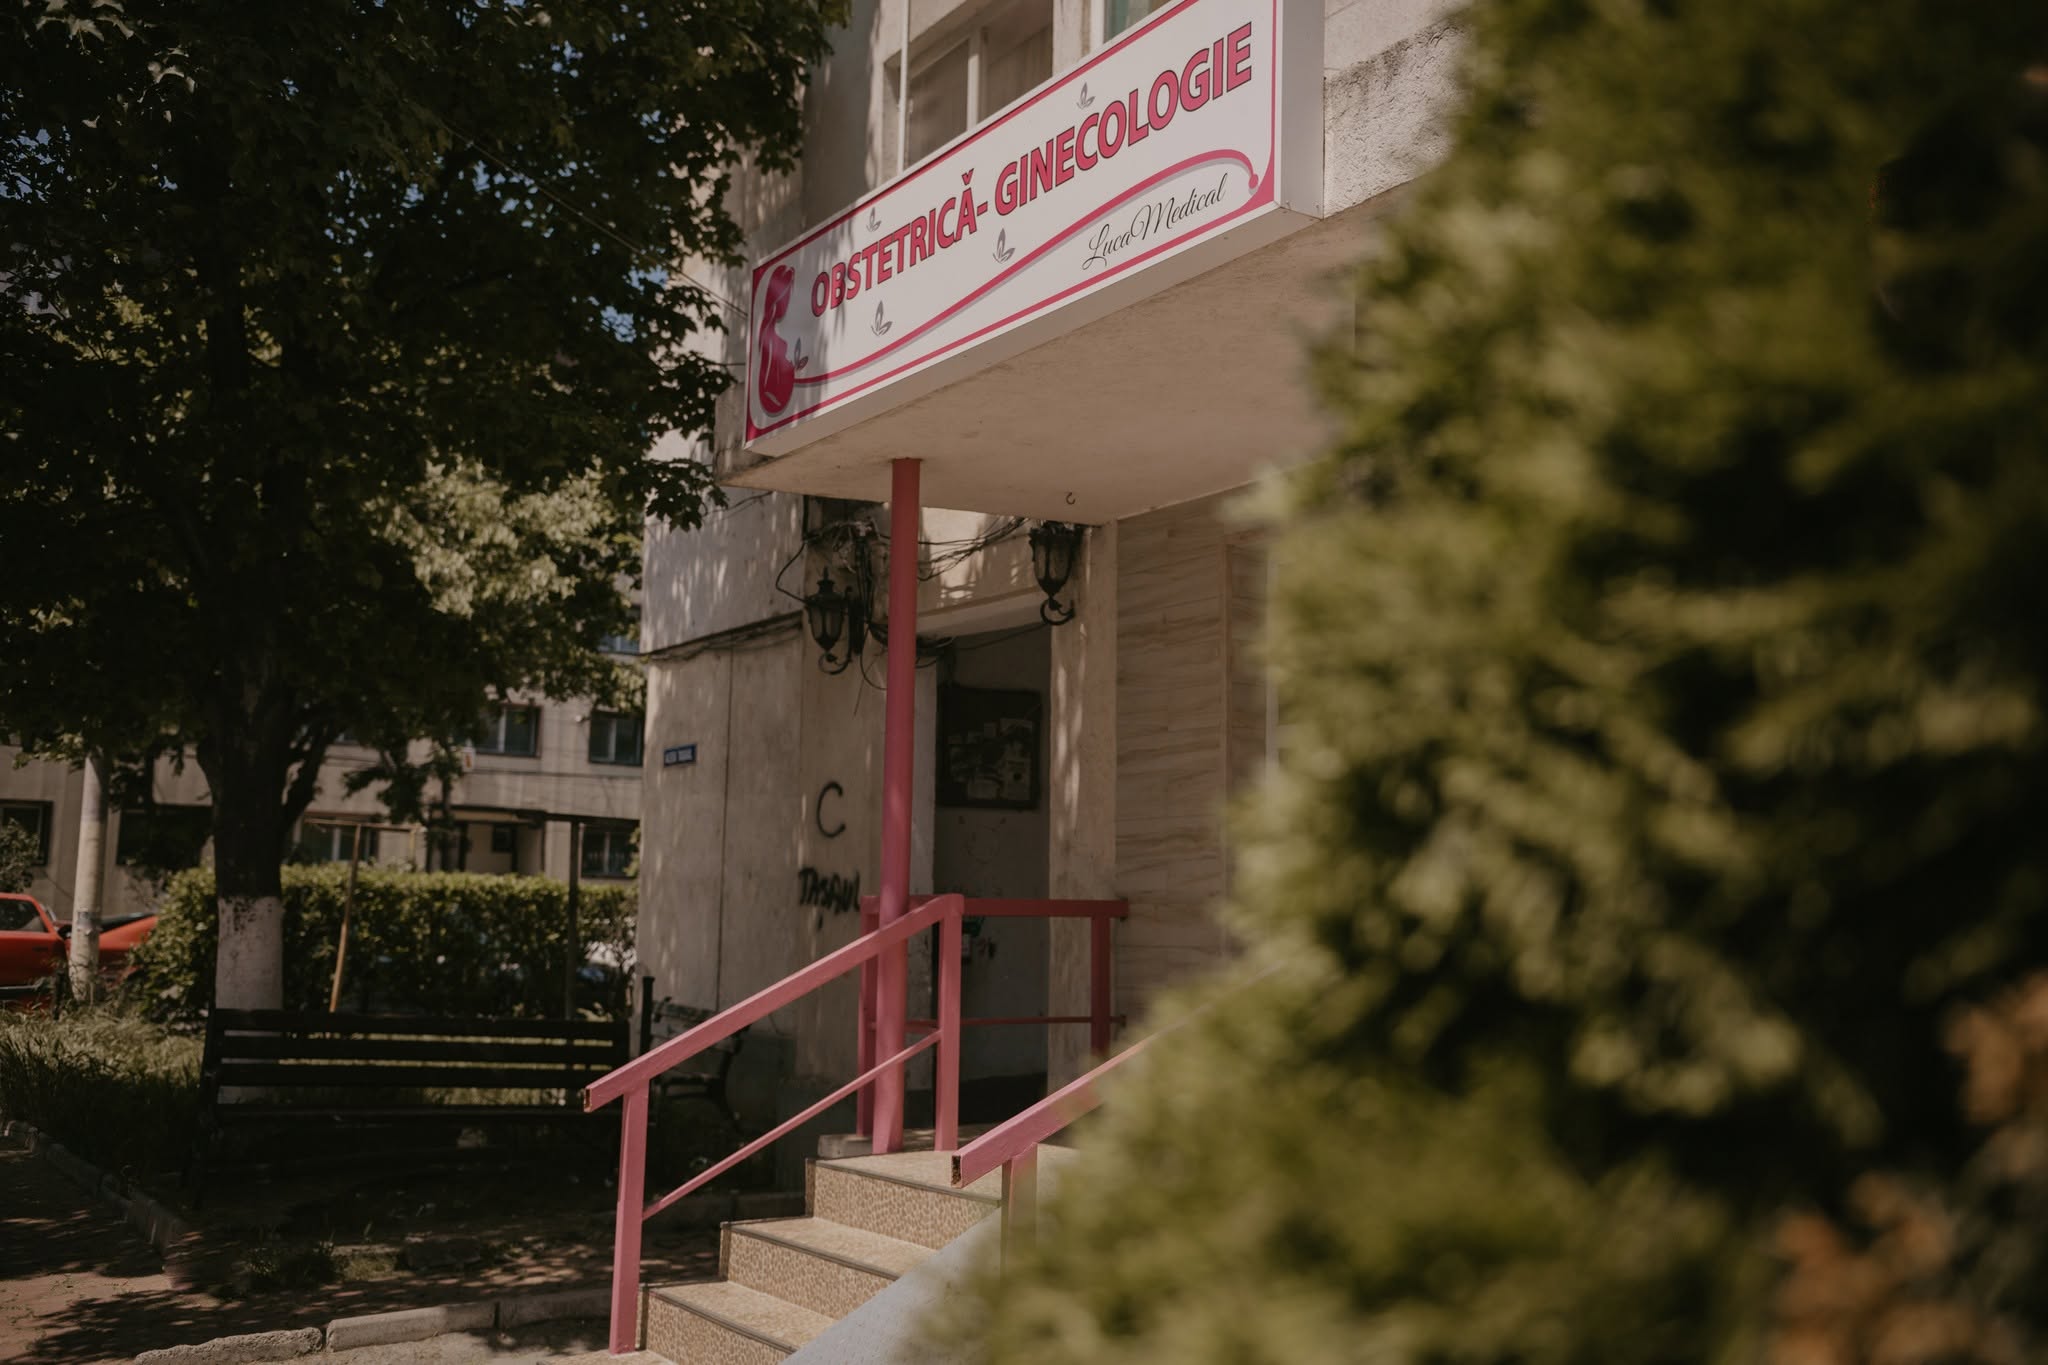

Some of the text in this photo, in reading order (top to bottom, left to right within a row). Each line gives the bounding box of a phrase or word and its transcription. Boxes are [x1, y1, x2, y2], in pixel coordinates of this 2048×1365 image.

[995, 21, 1252, 216] GINECOLOGIE
[1081, 172, 1228, 271] Luca Medical
[816, 781, 847, 838] C
